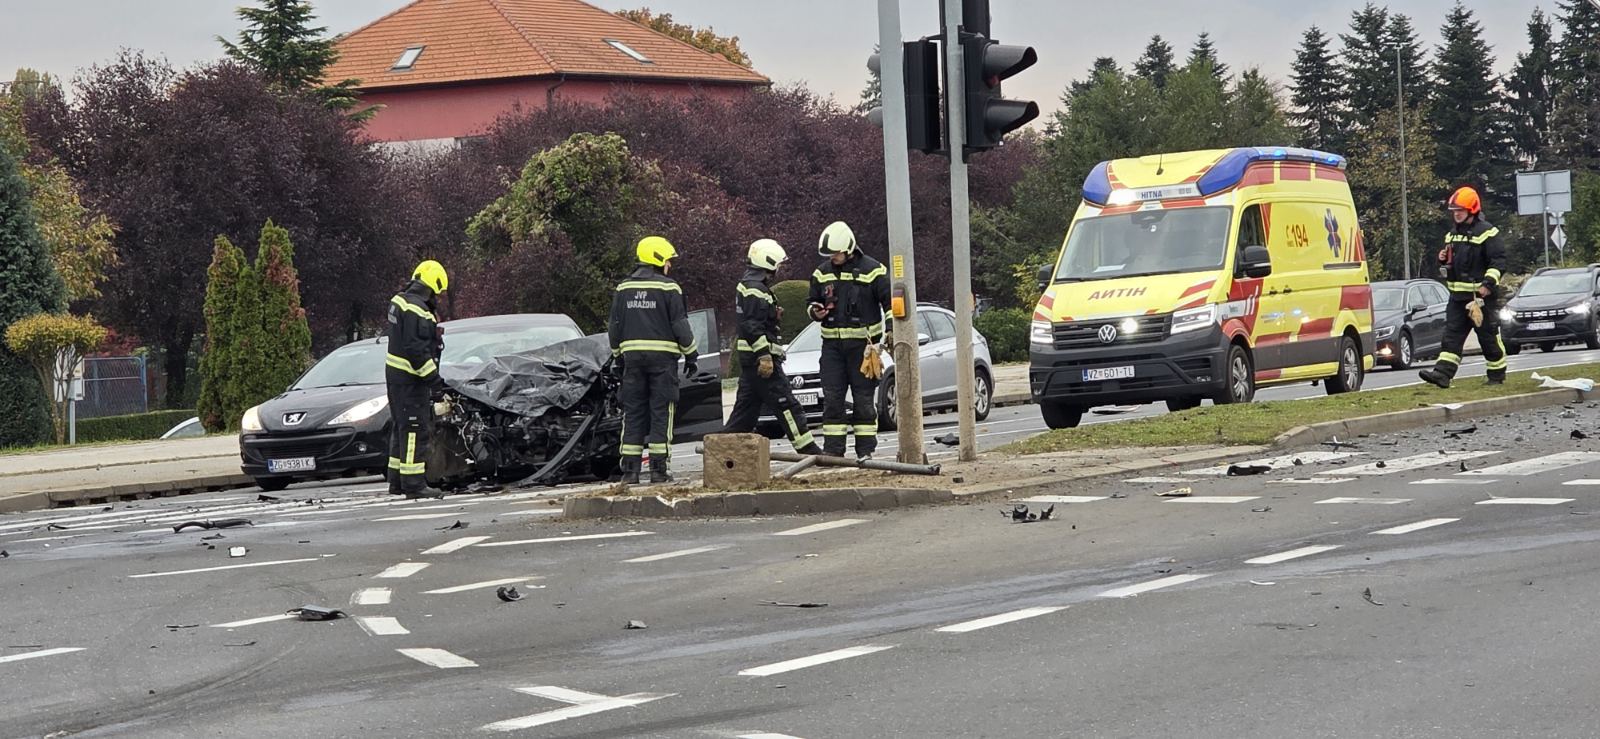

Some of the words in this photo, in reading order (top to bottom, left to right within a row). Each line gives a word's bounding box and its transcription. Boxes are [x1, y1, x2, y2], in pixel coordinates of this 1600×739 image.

[1141, 189, 1162, 199] HITNA
[1291, 224, 1309, 247] 194
[634, 291, 647, 299] JVP
[1098, 324, 1116, 343] VW
